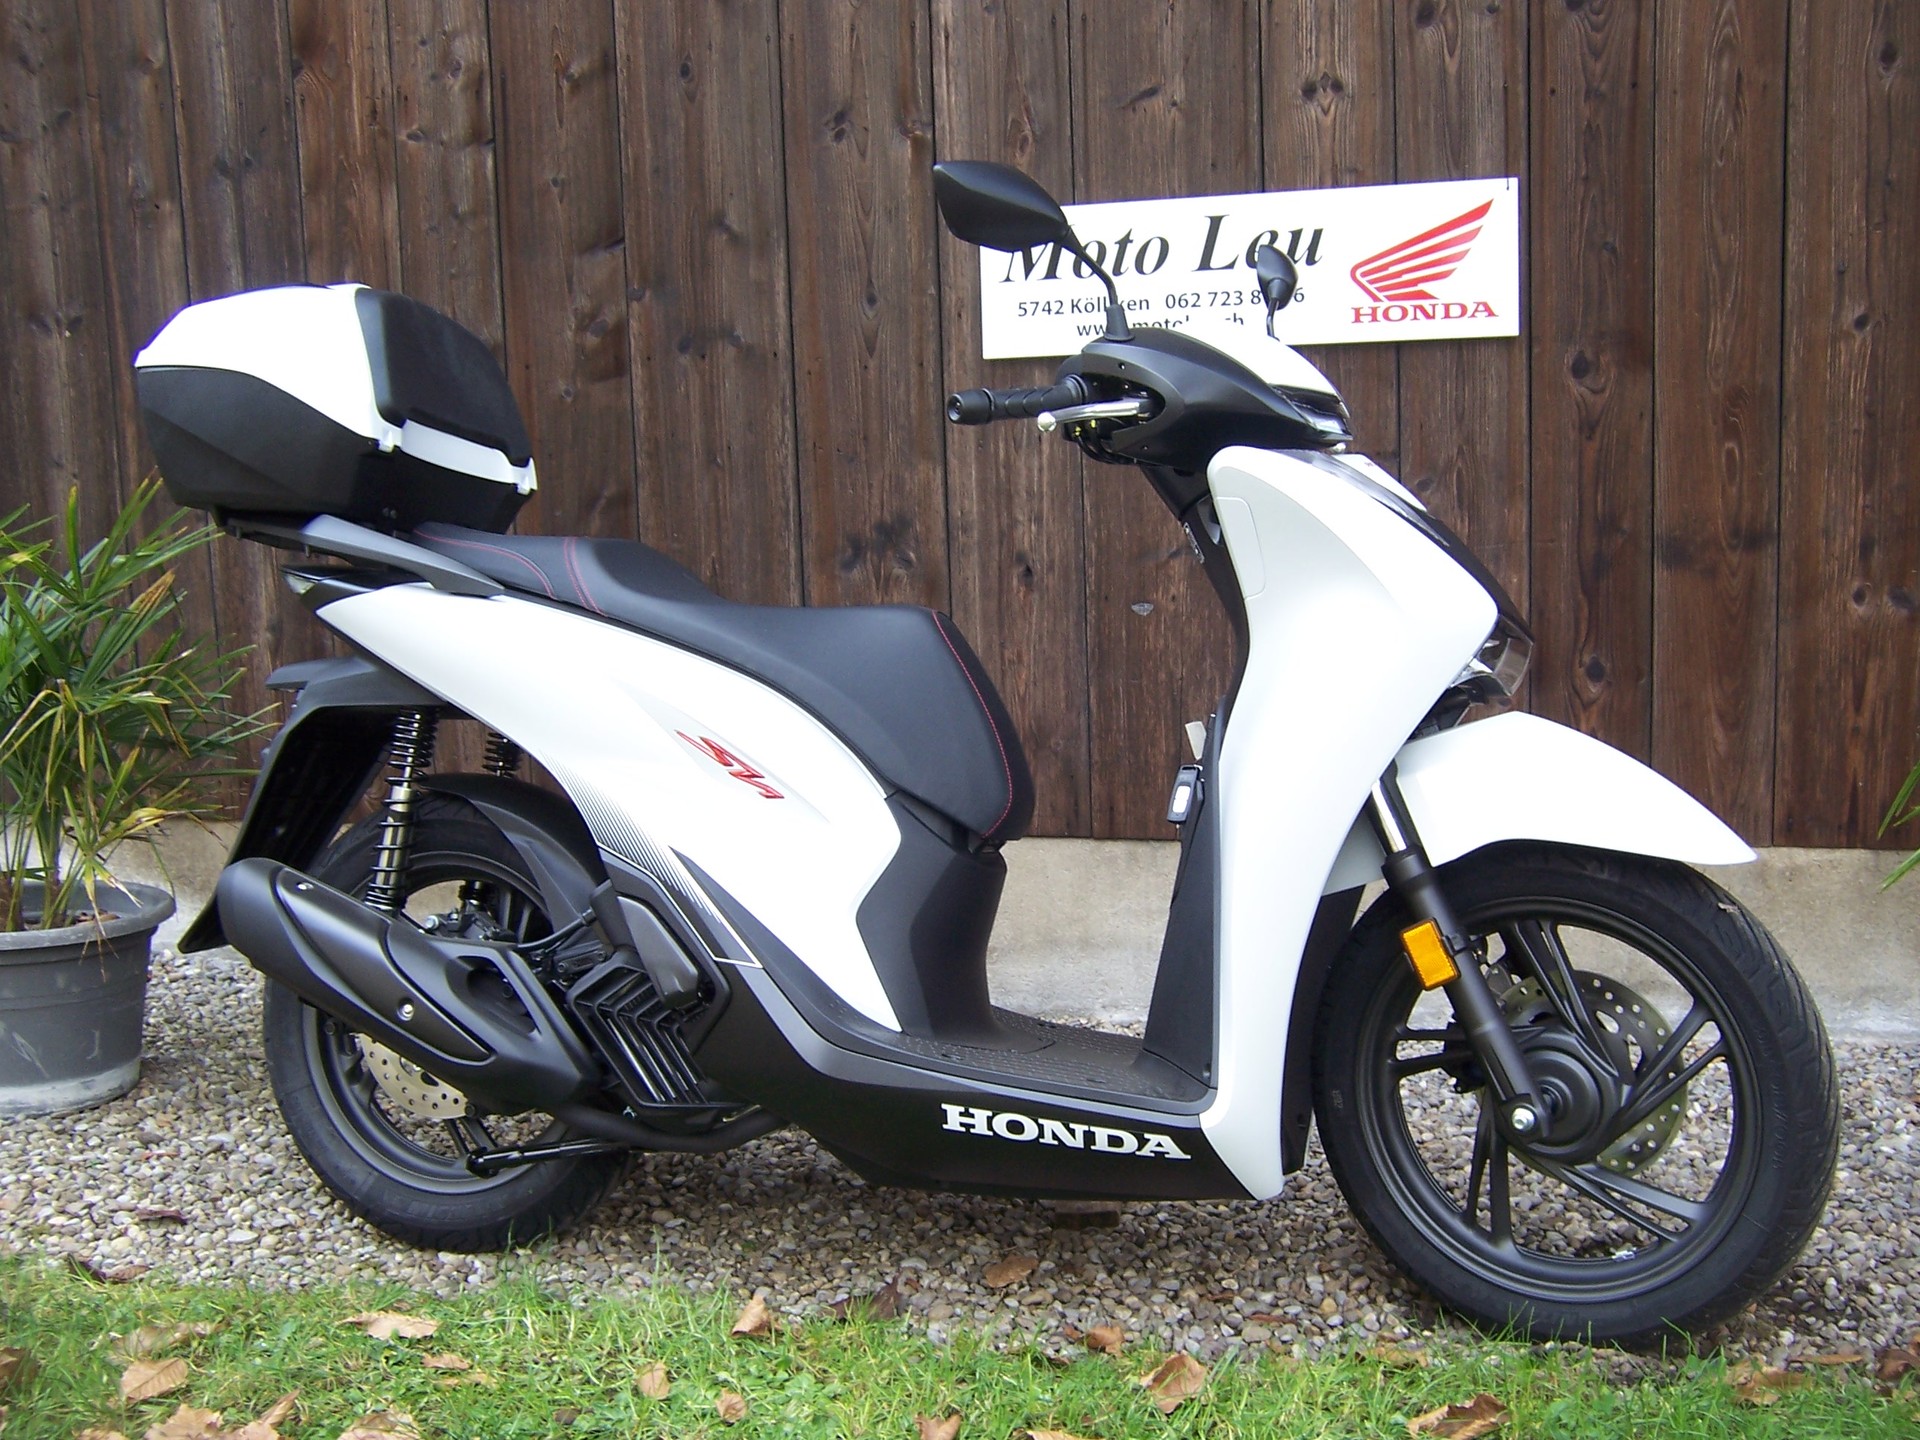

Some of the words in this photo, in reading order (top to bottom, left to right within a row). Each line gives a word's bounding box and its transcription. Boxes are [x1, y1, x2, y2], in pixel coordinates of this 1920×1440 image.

[998, 223, 1170, 284] Moto
[1017, 300, 1065, 317] 5742
[1071, 296, 1150, 314] Köllen
[1165, 292, 1201, 309] 062
[1207, 290, 1244, 307] 723
[1350, 301, 1499, 324] HONDA
[940, 1103, 1192, 1160] HONDA
